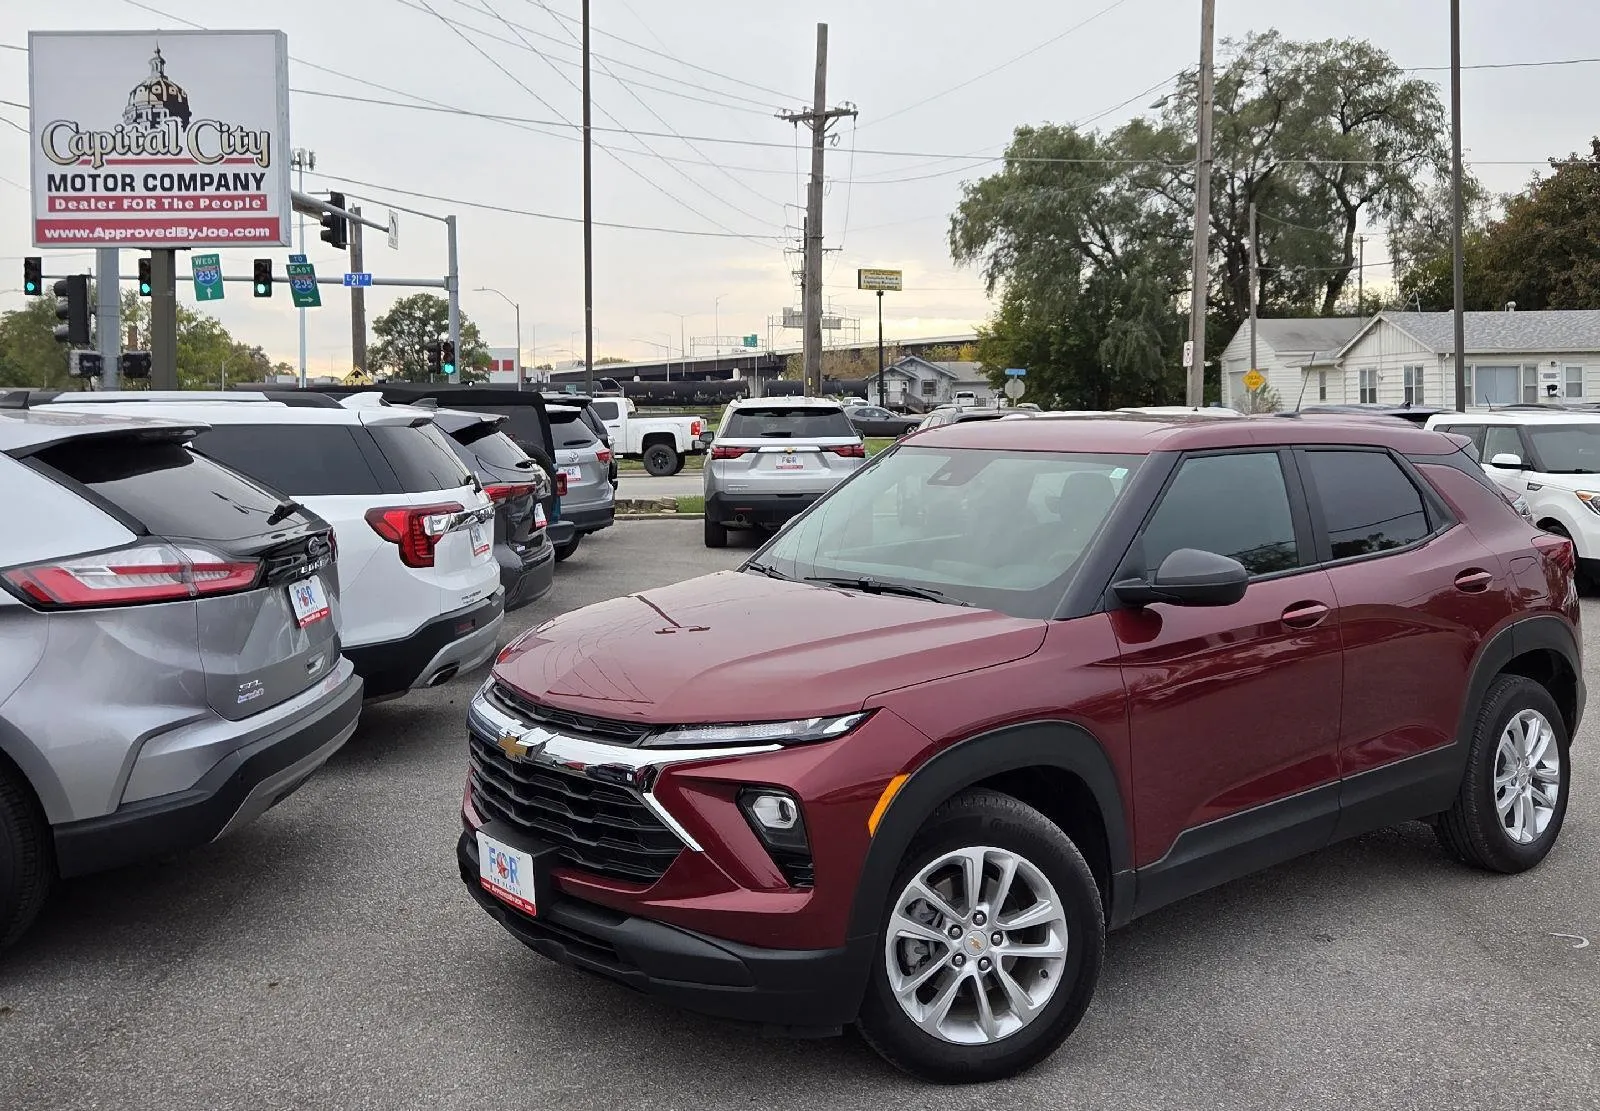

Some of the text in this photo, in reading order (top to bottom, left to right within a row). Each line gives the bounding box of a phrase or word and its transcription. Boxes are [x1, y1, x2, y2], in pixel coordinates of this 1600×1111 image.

[41, 119, 271, 169] Capital City
[47, 172, 266, 193] MOTOR COMPANY
[55, 197, 262, 211] Dealer FOR The People
[44, 227, 270, 240] www.ApprovedByJoe.com
[194, 256, 217, 265] WEST
[196, 270, 218, 280] 235
[289, 264, 311, 274] EAST
[294, 279, 313, 289] 235
[489, 847, 520, 886] FOR
